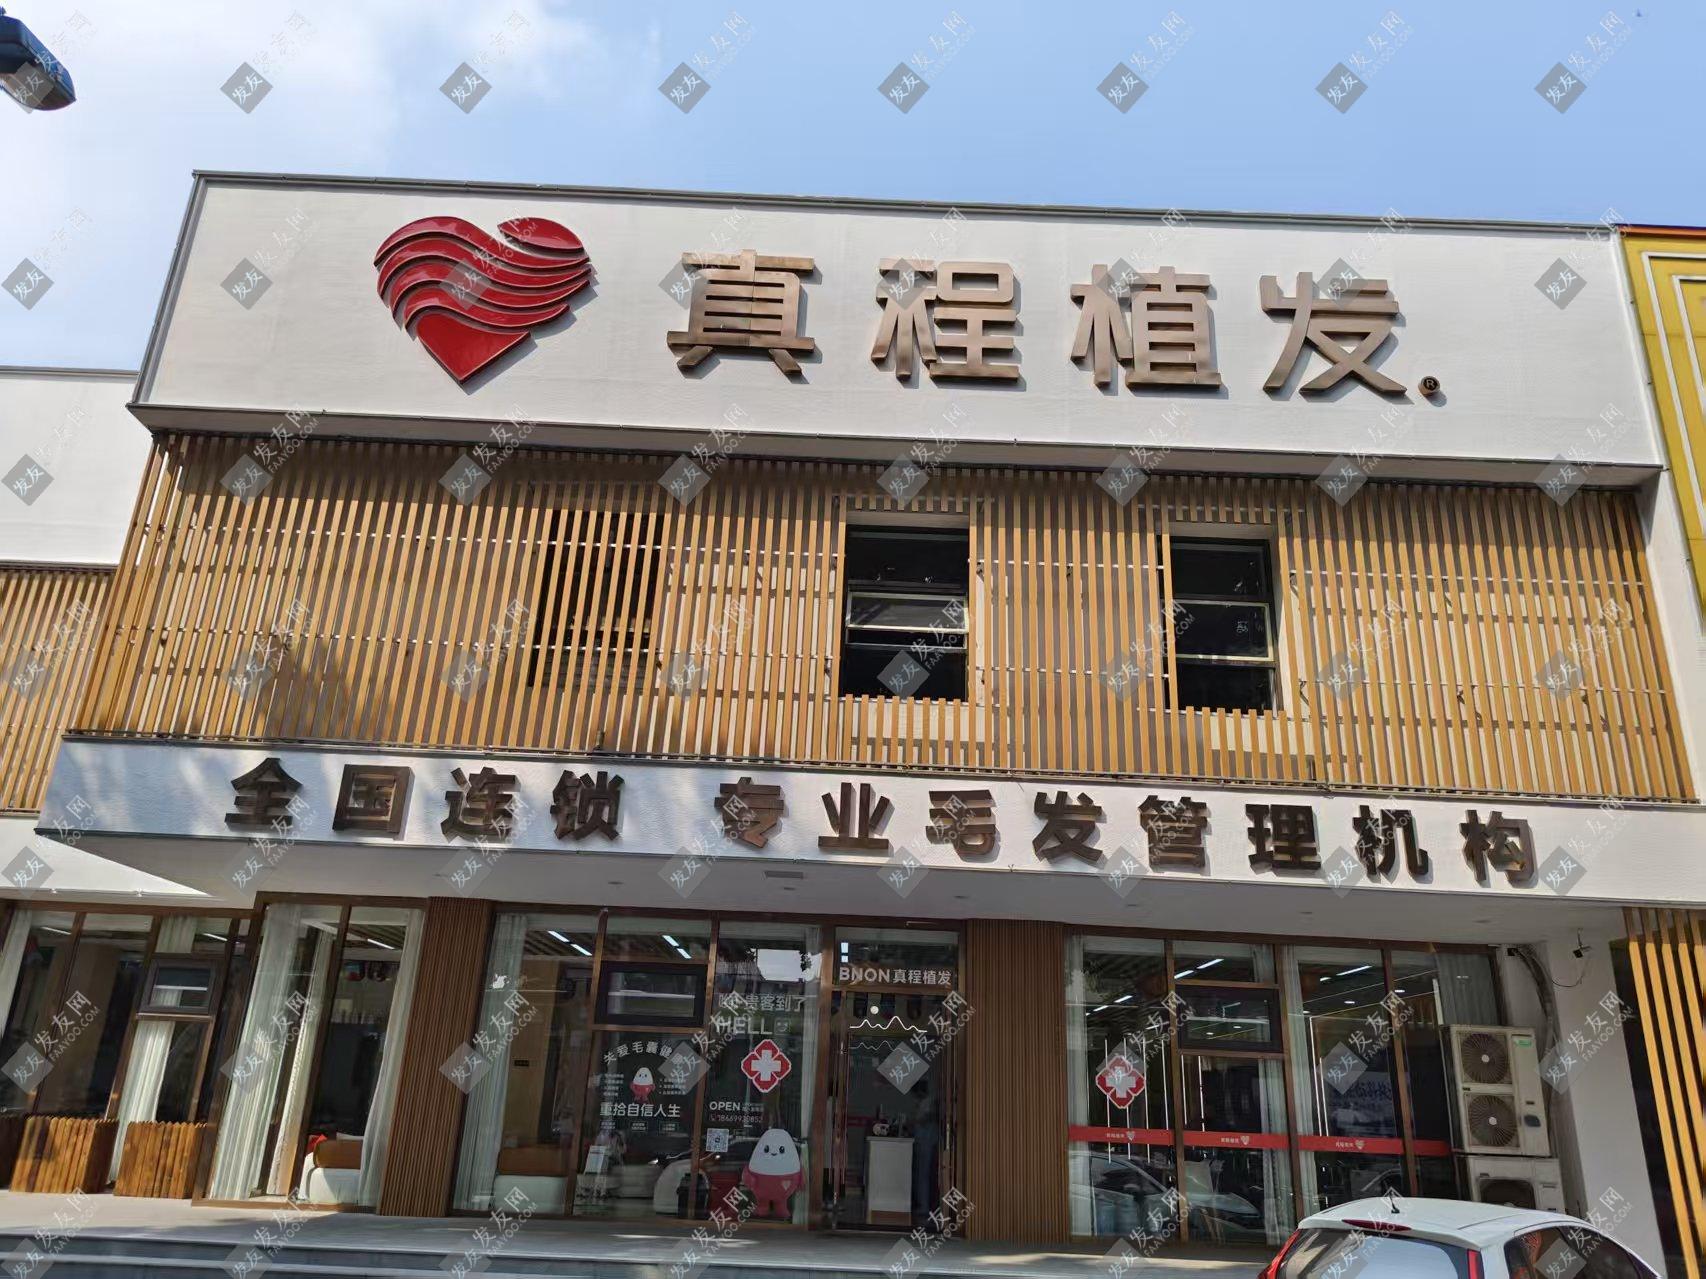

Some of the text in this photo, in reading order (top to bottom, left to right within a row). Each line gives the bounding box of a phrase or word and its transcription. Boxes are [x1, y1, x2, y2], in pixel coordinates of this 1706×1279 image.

[667, 249, 1407, 394] 真程植发
[225, 757, 1534, 886] 全国连锁 专业毛发管理机构
[892, 969, 951, 985] 真程植发
[600, 1102, 680, 1117] 重拾自信人生
[709, 1101, 740, 1111] OPEN
